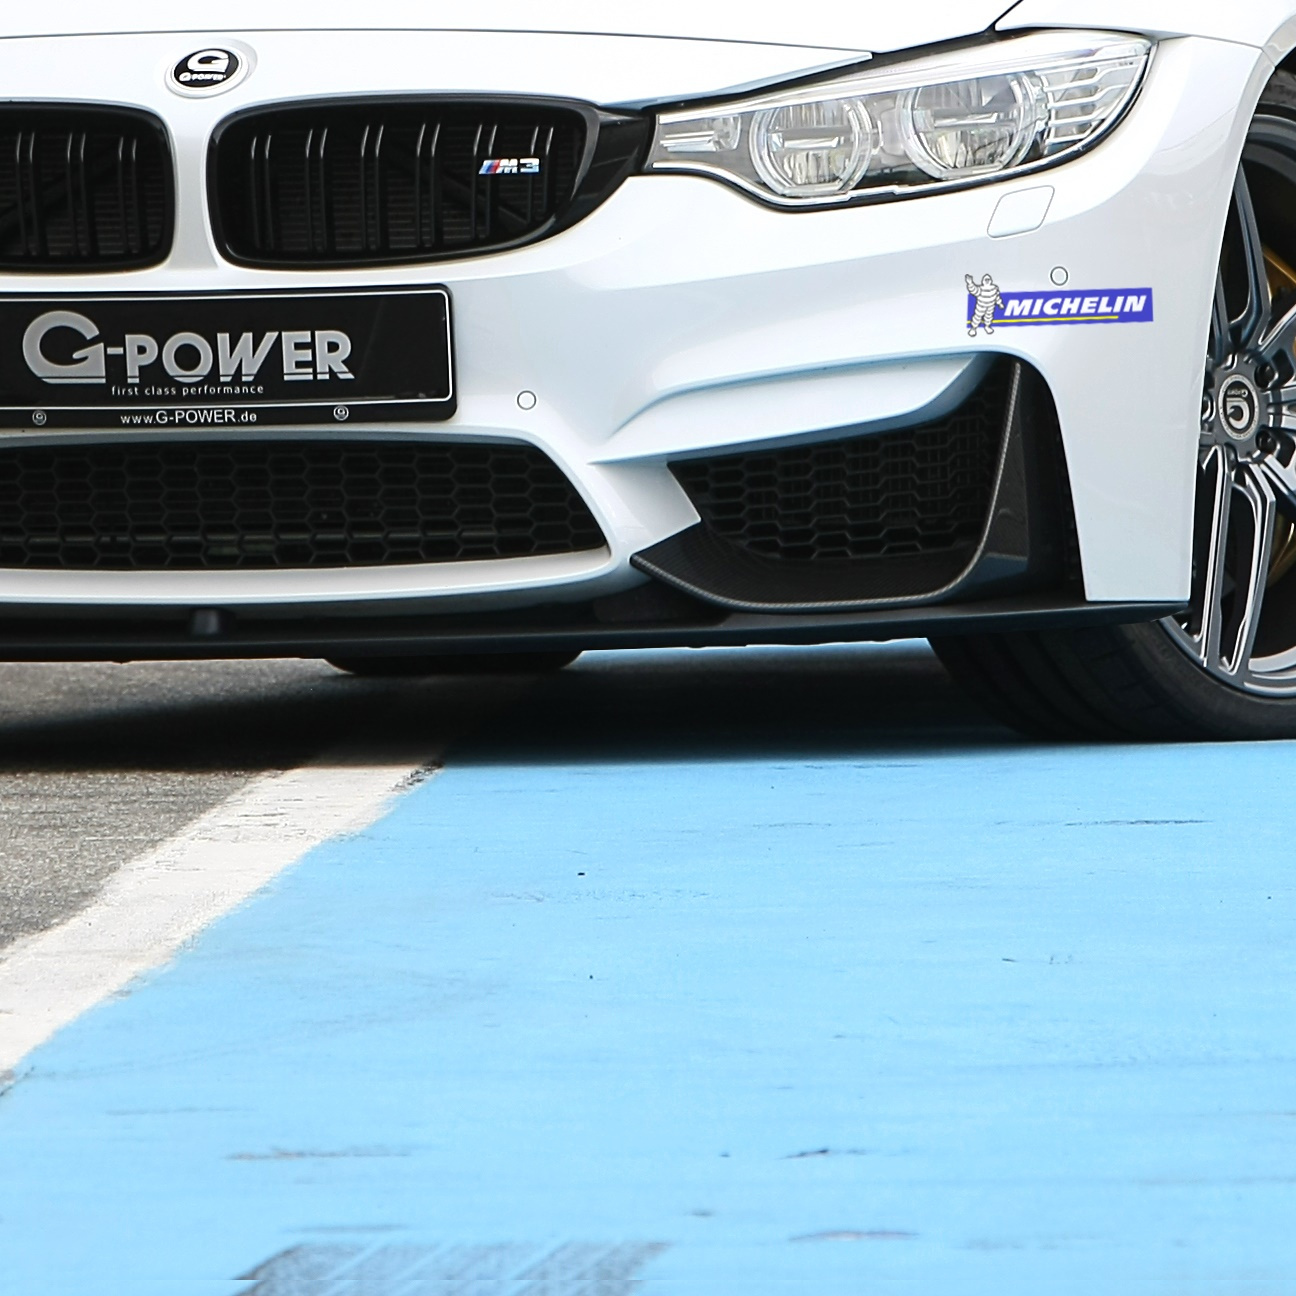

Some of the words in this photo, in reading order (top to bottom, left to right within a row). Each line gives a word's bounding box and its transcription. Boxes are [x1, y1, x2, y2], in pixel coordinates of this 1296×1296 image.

[494, 157, 540, 174] M3
[1004, 294, 1148, 317] MICHELIN
[22, 310, 356, 384] G-POWER
[111, 385, 140, 396] first
[144, 385, 177, 396] class
[182, 384, 264, 397] performance
[120, 409, 258, 424] www.G-POWER.de
